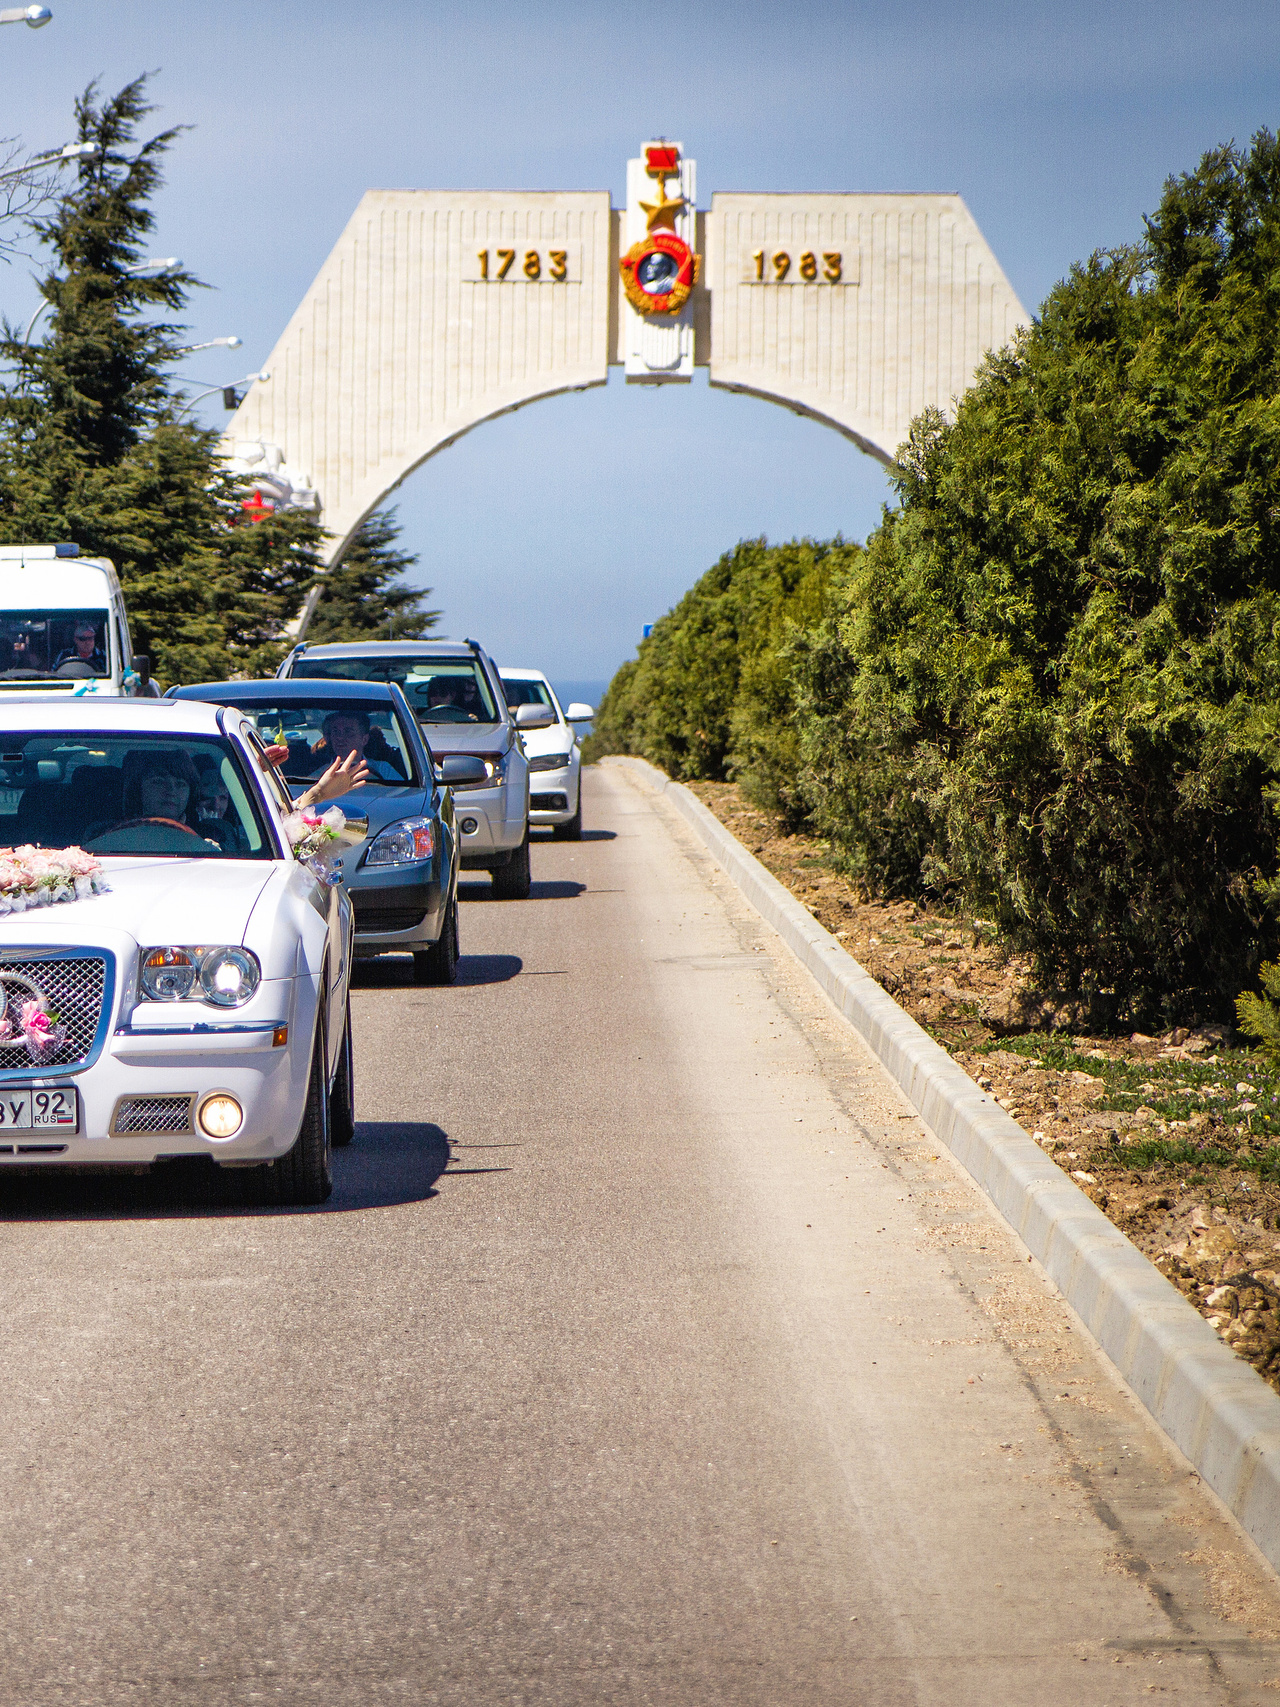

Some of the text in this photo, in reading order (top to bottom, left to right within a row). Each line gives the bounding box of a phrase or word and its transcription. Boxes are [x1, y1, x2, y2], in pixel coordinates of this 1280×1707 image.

[477, 248, 567, 281] 1783
[752, 249, 842, 283] 1983
[35, 1091, 66, 1115] 92
[34, 1115, 57, 1124] RUS
